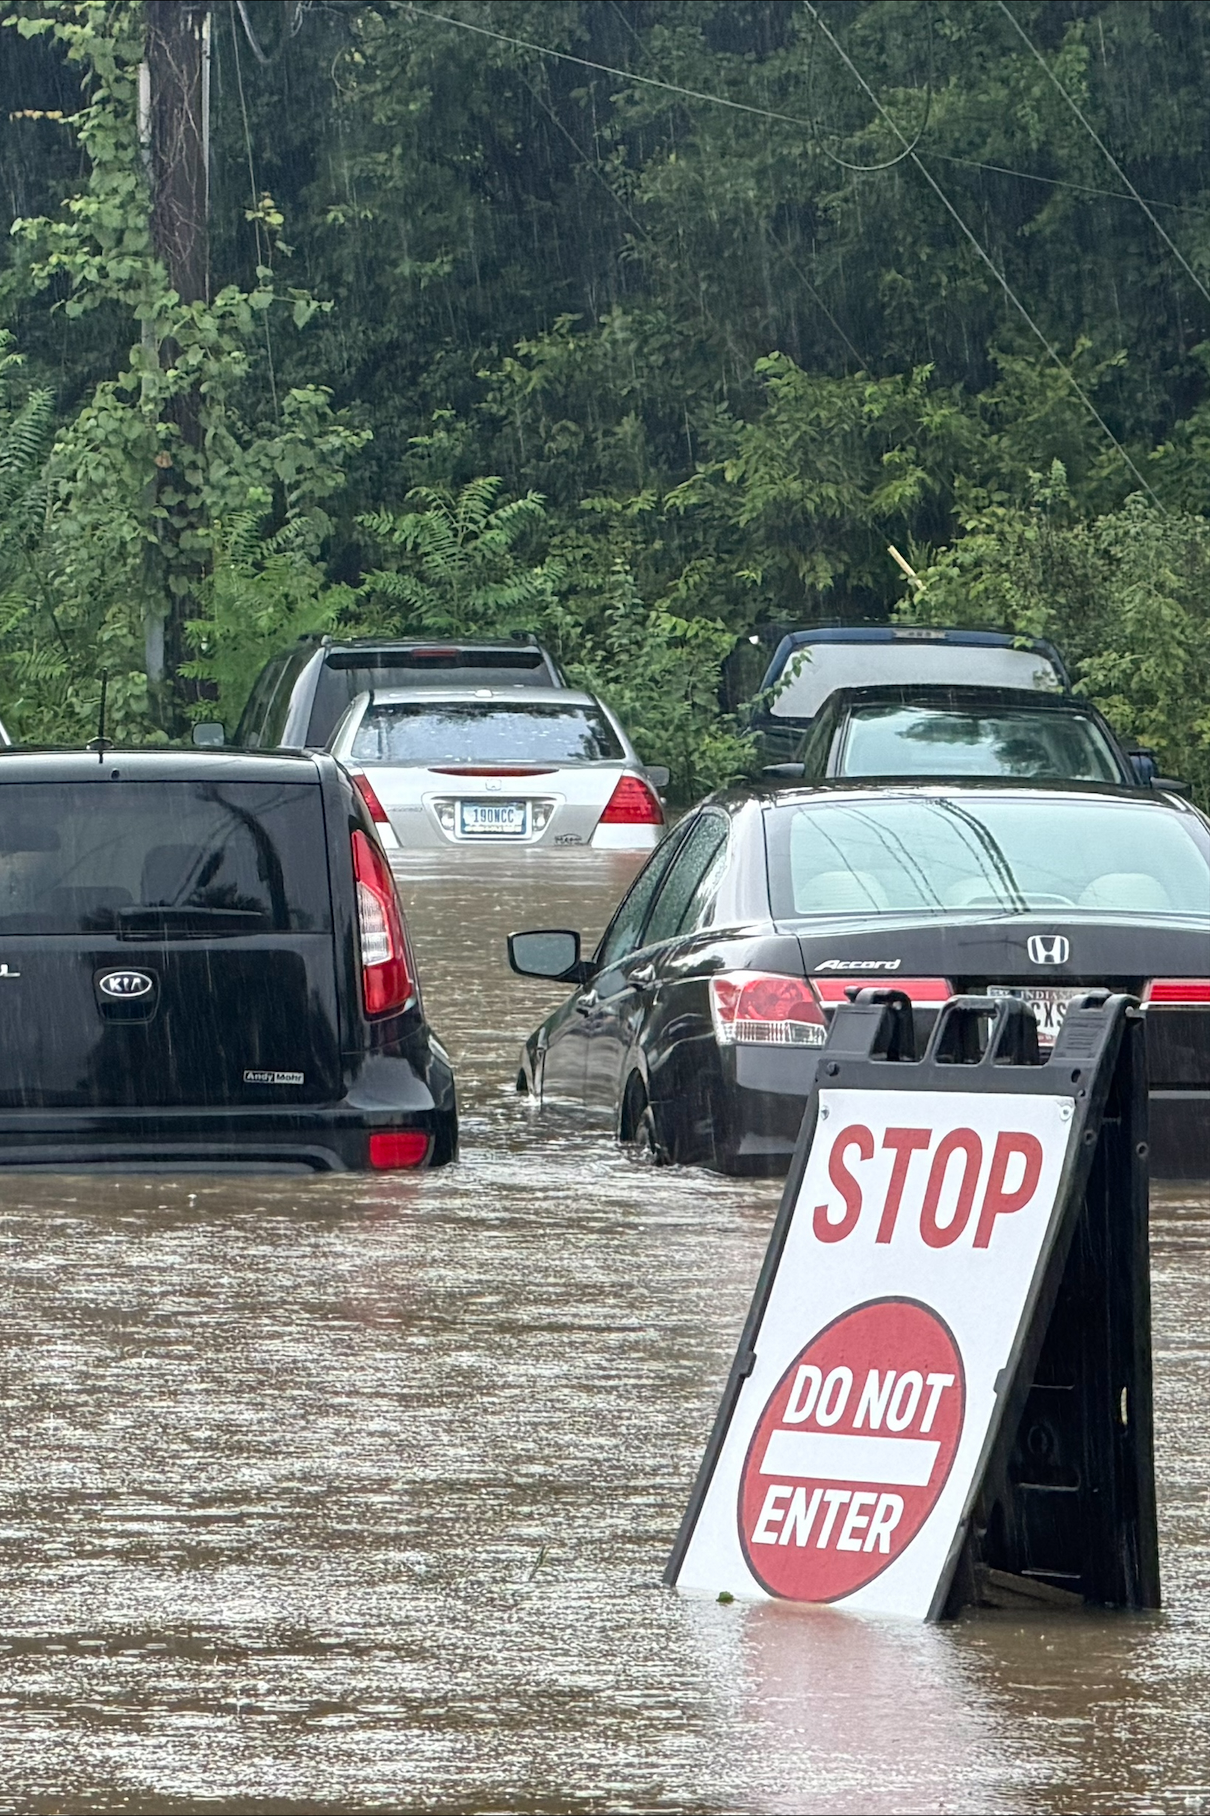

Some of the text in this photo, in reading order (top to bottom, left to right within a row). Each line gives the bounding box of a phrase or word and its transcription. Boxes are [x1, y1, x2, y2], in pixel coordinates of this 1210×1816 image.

[108, 976, 146, 994] KIA
[814, 958, 901, 971] Accord
[246, 1071, 302, 1083] Andy Mohr
[812, 1124, 1044, 1250] STOP
[782, 1364, 955, 1434] DO NOT
[751, 1484, 905, 1555] ENTER
